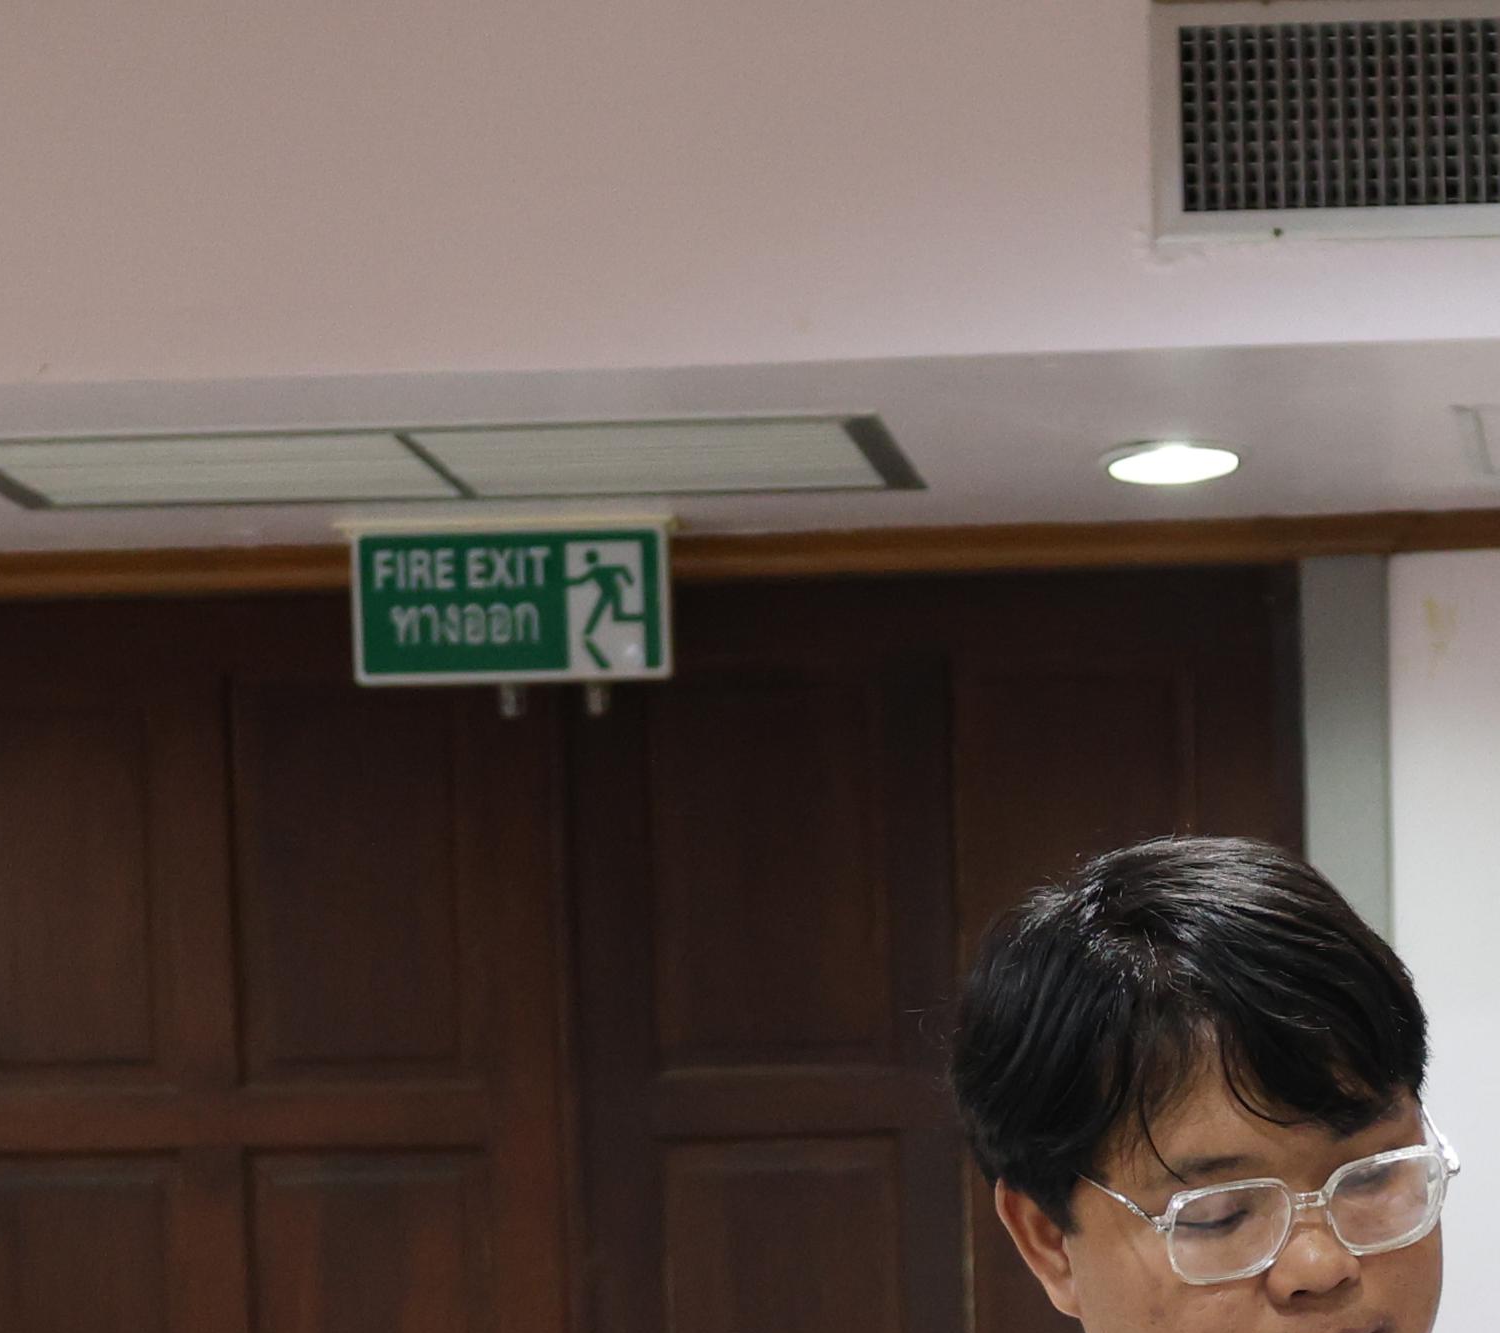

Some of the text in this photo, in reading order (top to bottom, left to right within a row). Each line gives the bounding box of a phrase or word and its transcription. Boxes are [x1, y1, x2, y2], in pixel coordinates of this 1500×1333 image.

[374, 546, 551, 590] FIRE EXIT
[390, 603, 540, 647] ทางออก
